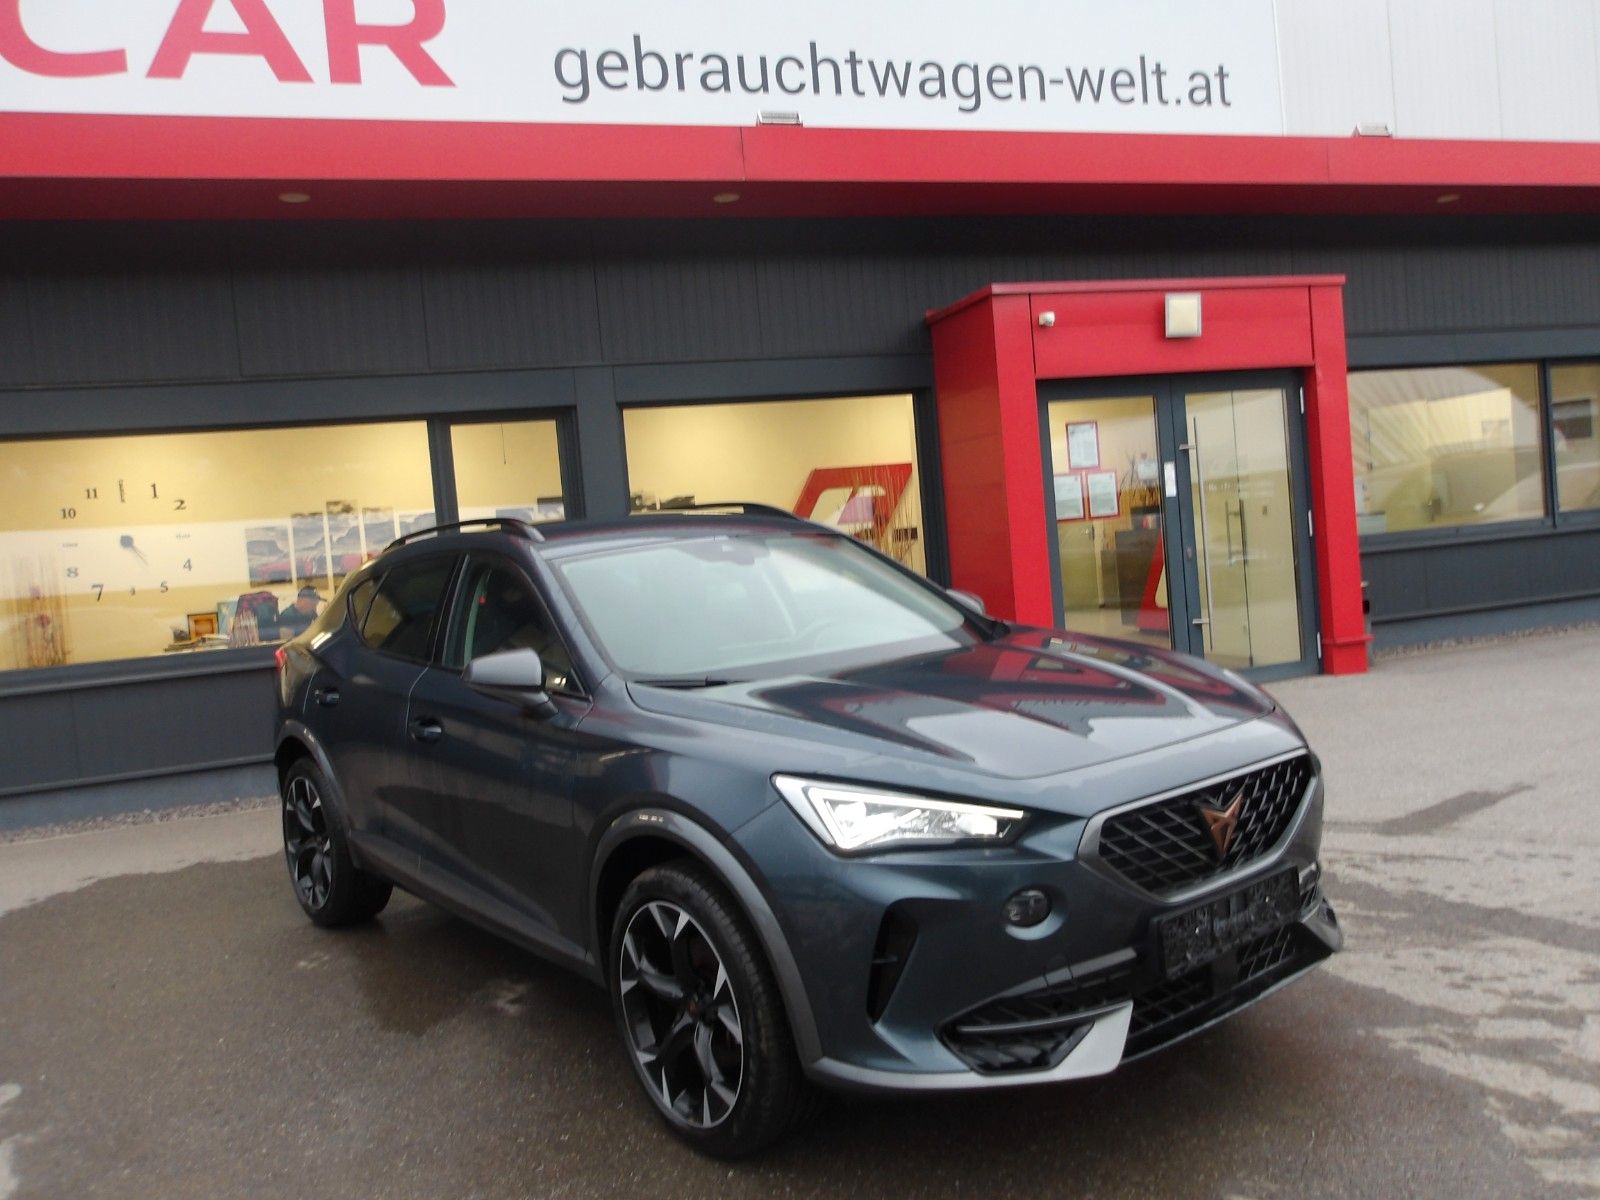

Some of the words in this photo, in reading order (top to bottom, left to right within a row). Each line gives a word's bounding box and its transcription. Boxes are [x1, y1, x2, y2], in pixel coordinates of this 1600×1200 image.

[554, 34, 1232, 114] gebrauchtwagen-welt.at
[86, 488, 98, 500] 11
[150, 483, 159, 499] 1
[174, 499, 187, 511] 2
[61, 507, 77, 519] 10
[182, 558, 192, 571] 4
[91, 583, 104, 602] 7
